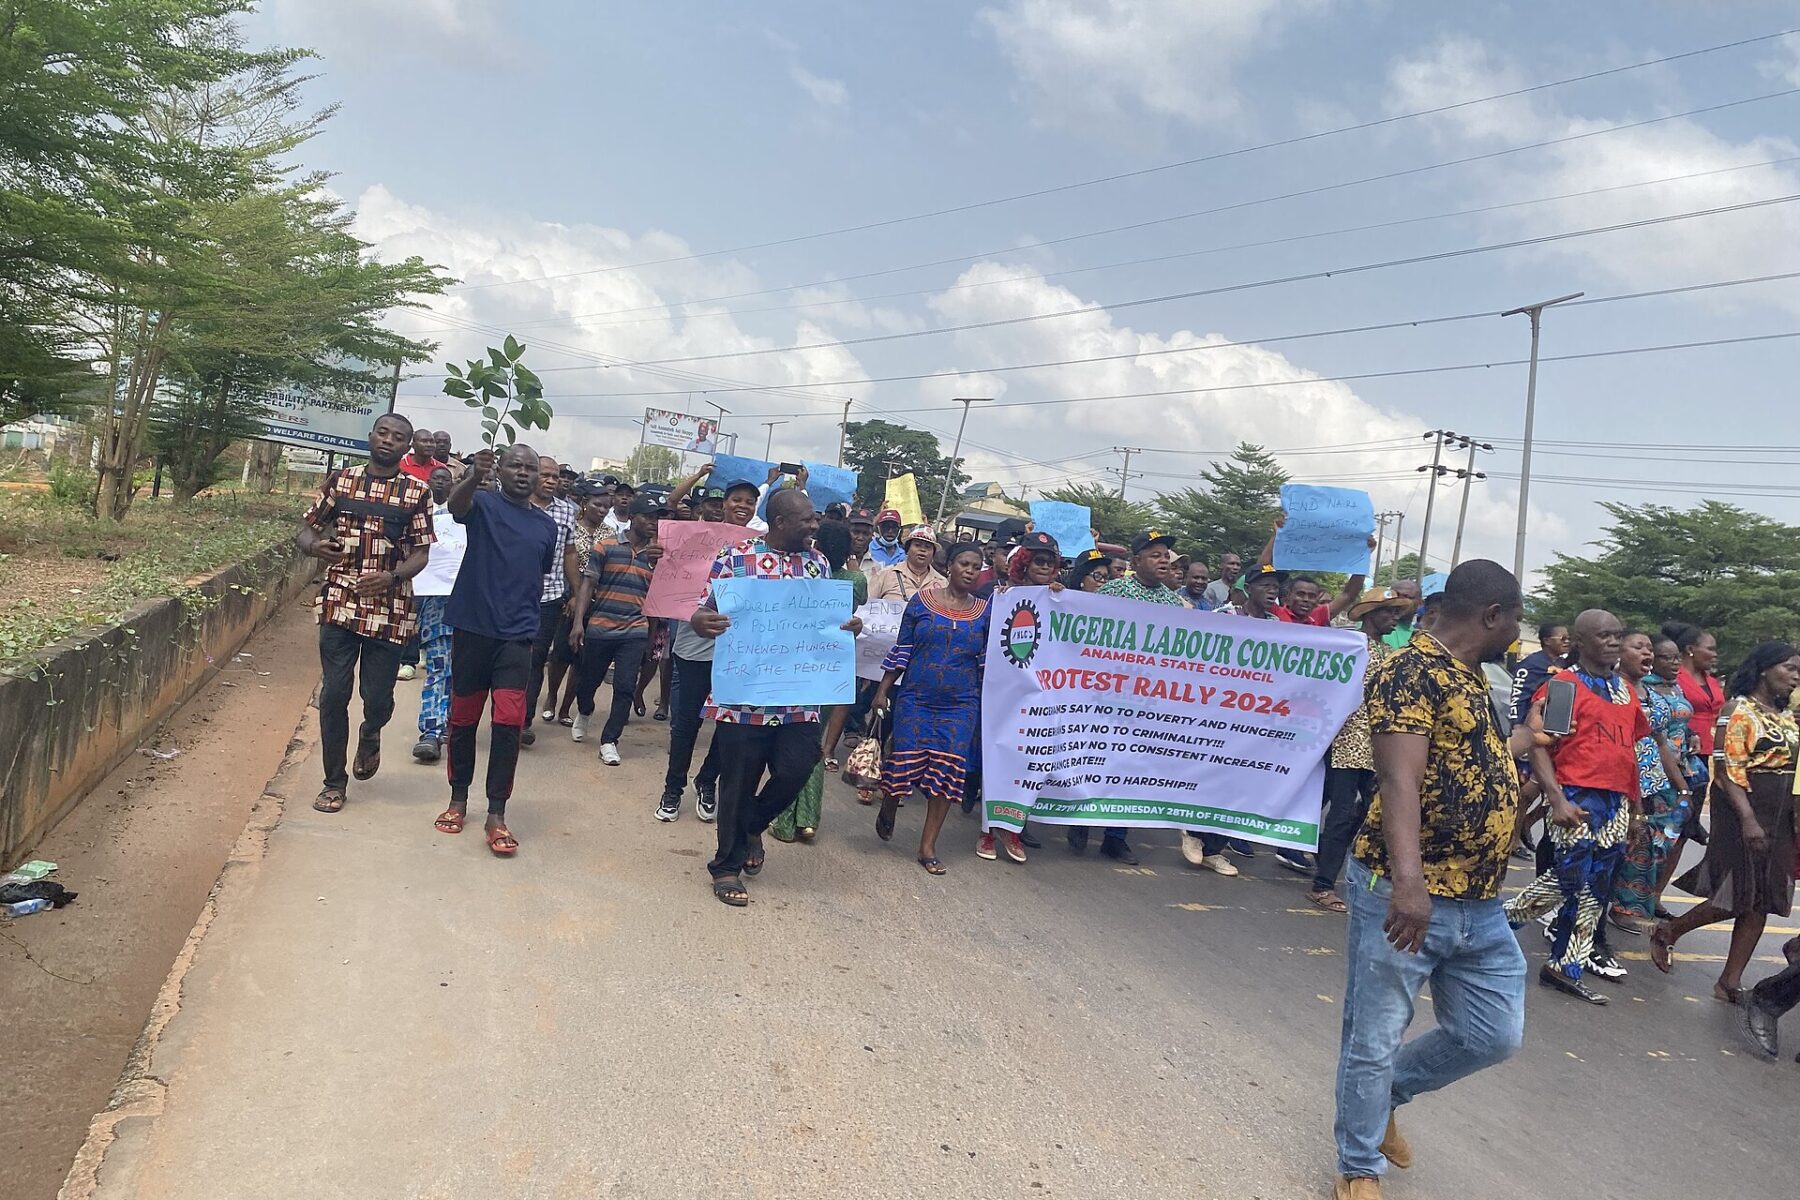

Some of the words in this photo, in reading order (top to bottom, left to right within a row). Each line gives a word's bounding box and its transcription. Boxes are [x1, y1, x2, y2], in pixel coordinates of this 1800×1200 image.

[310, 399, 373, 416] PARTNERSHIP
[273, 427, 316, 440] WELFARE
[317, 434, 337, 444] FOR
[338, 438, 356, 447] ALL
[1289, 494, 1319, 511] END
[724, 591, 781, 613] DOUBLE
[787, 596, 852, 609] ALLOCATION
[869, 601, 903, 616] END
[752, 618, 827, 632] POLITICIANS
[727, 632, 790, 655] RENEWED
[796, 640, 843, 654] HUNGER
[1048, 609, 1137, 650] NIGERIA
[1140, 623, 1234, 665] LABOUR
[1237, 638, 1357, 684] CONGRESS
[723, 660, 751, 676] FOR
[755, 662, 786, 676] THE
[793, 660, 842, 675] PEOPLE
[1080, 647, 1156, 667] ANAMBRA
[1159, 658, 1205, 673] STATE
[1208, 665, 1274, 684] COUNCIL
[1035, 668, 1129, 693] PROTEST
[1132, 676, 1217, 705] RALLY
[1219, 690, 1291, 717] 2024
[1069, 704, 1093, 714] SAY
[1094, 705, 1113, 715] NO
[1117, 707, 1134, 717] TO
[1136, 710, 1198, 726] POVERTY
[1198, 719, 1228, 730] AND
[1230, 723, 1296, 741] HUNGER!!!
[1067, 724, 1089, 734] SAY
[1090, 724, 1109, 734] NO
[1113, 726, 1129, 736] TO
[1132, 728, 1226, 748] CRIMINALITY!!!
[1595, 721, 1636, 749] NL
[1027, 758, 1070, 773] EXCHANGE
[1070, 756, 1107, 767] RATE!!!
[1068, 741, 1087, 751] SAY
[1088, 741, 1107, 751] NO
[1110, 742, 1127, 753] TO
[1129, 744, 1209, 762] CONSISTENT
[1209, 755, 1274, 772] INCREASE
[1274, 764, 1291, 776] IN
[1021, 777, 1072, 791] NIGRIANS
[1072, 774, 1085, 787] SAY
[1084, 774, 1102, 784] NO
[1105, 775, 1121, 785] TO
[1123, 776, 1198, 792] HARDSHIP!!!
[993, 805, 1027, 820] DATE:
[1055, 804, 1077, 812] 27TH
[1076, 803, 1098, 812] AND
[1100, 804, 1165, 815] WEDNESDAY
[1166, 807, 1194, 818] 28TH
[1196, 811, 1212, 820] OF
[1213, 813, 1273, 831] FEBRUARY
[1273, 824, 1301, 836] 2024
